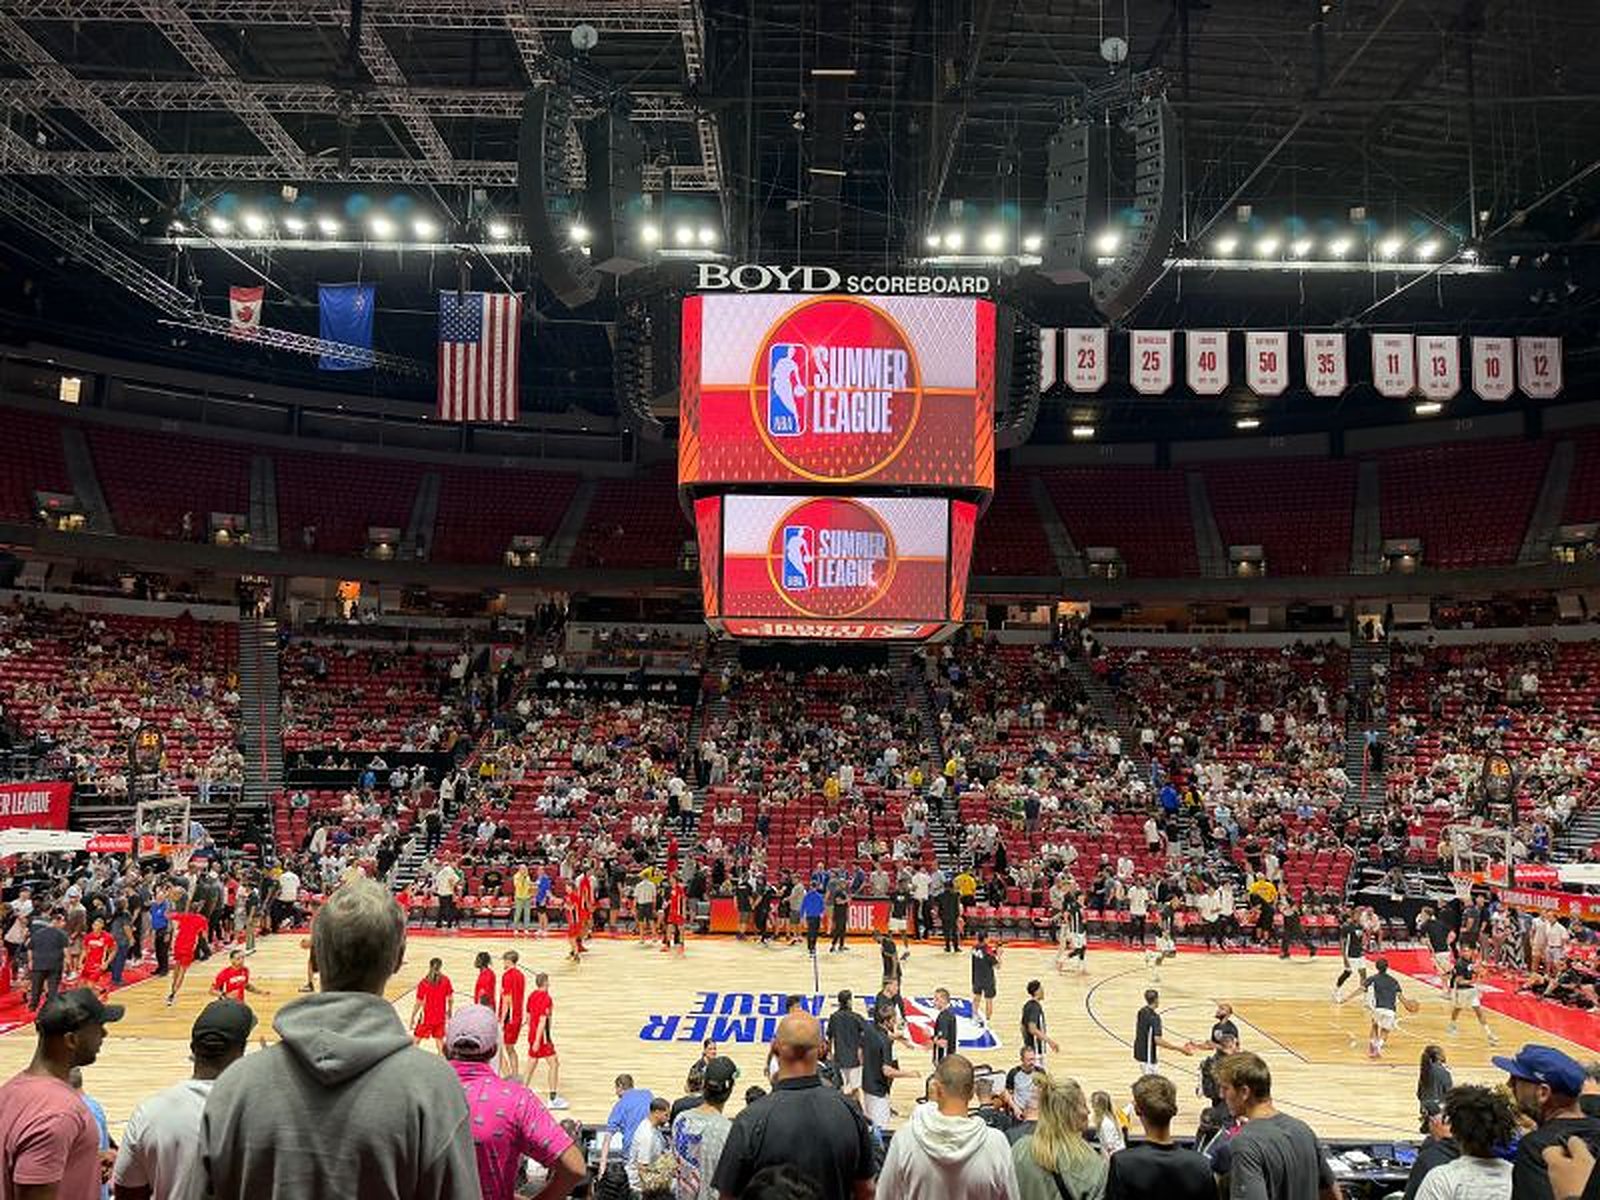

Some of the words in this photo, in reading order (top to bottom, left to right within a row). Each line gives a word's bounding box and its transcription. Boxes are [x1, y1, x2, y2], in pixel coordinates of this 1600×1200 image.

[696, 263, 840, 293] BOYD
[847, 275, 990, 294] SCOREBOARD
[813, 346, 908, 390] SUMMER
[1077, 349, 1096, 369] 23
[1142, 350, 1160, 371] 25
[1198, 352, 1216, 372] 40
[1259, 352, 1277, 373] 50
[1317, 353, 1335, 374] 35
[1387, 353, 1400, 374] 11
[1431, 356, 1447, 377] 13
[1486, 357, 1500, 378] 10
[1533, 355, 1549, 377] 12
[813, 390, 894, 433] LEAGUE
[818, 529, 888, 558] SUMMER
[818, 559, 876, 588] LEAGUE
[11, 791, 52, 815] LEAGUE
[846, 905, 875, 930] GUE
